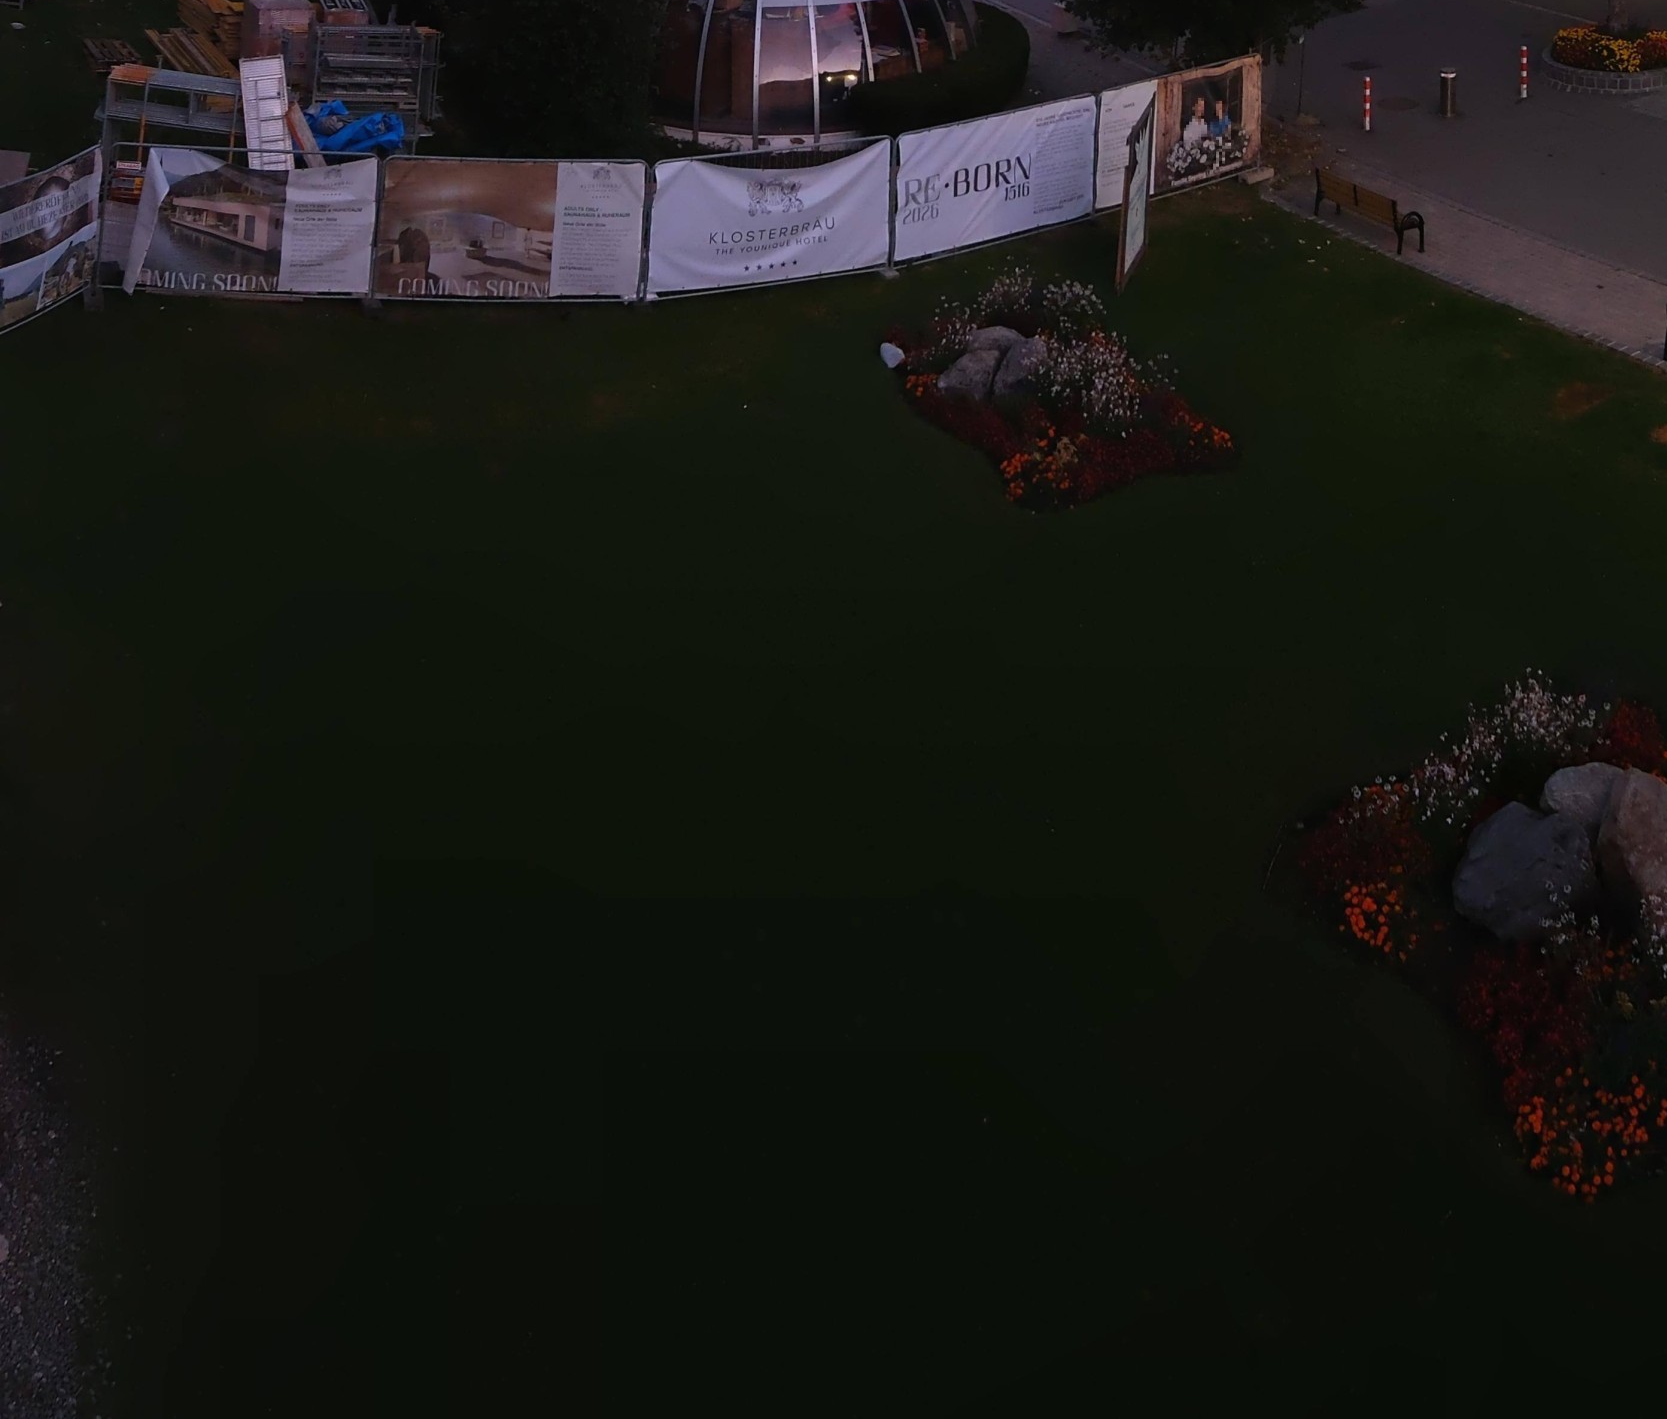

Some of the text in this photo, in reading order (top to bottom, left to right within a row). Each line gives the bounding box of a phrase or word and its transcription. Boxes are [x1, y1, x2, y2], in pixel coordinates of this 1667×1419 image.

[1004, 180, 1031, 202] 1516
[902, 203, 940, 226] 2026
[708, 216, 836, 245] KLOSTERBRÄU
[714, 235, 829, 256] THE YOUNIQUE HOTEL
